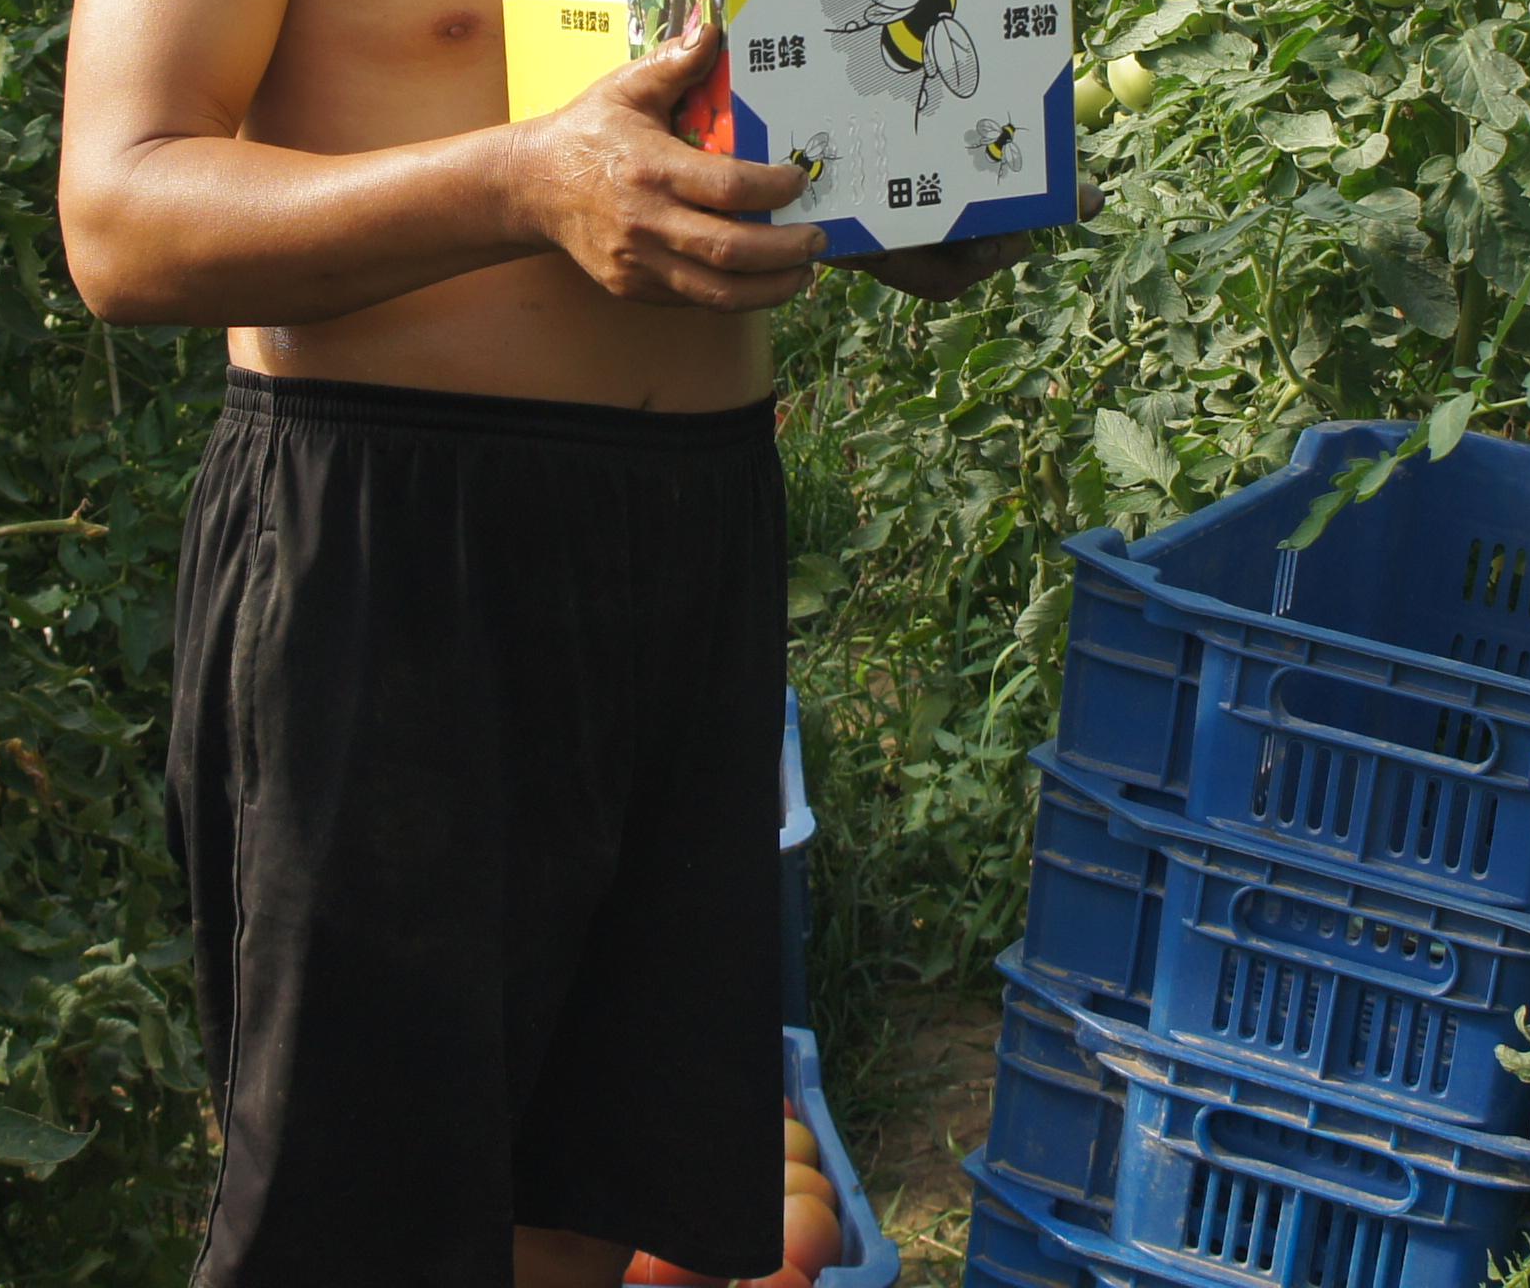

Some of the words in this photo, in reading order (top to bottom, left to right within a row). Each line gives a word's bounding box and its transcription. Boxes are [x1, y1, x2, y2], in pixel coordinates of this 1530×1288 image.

[561, 8, 609, 33] 熊蜂授粉
[1004, 4, 1058, 39] 授粉
[749, 35, 806, 72] 熊蜂
[888, 173, 942, 208] 田益
